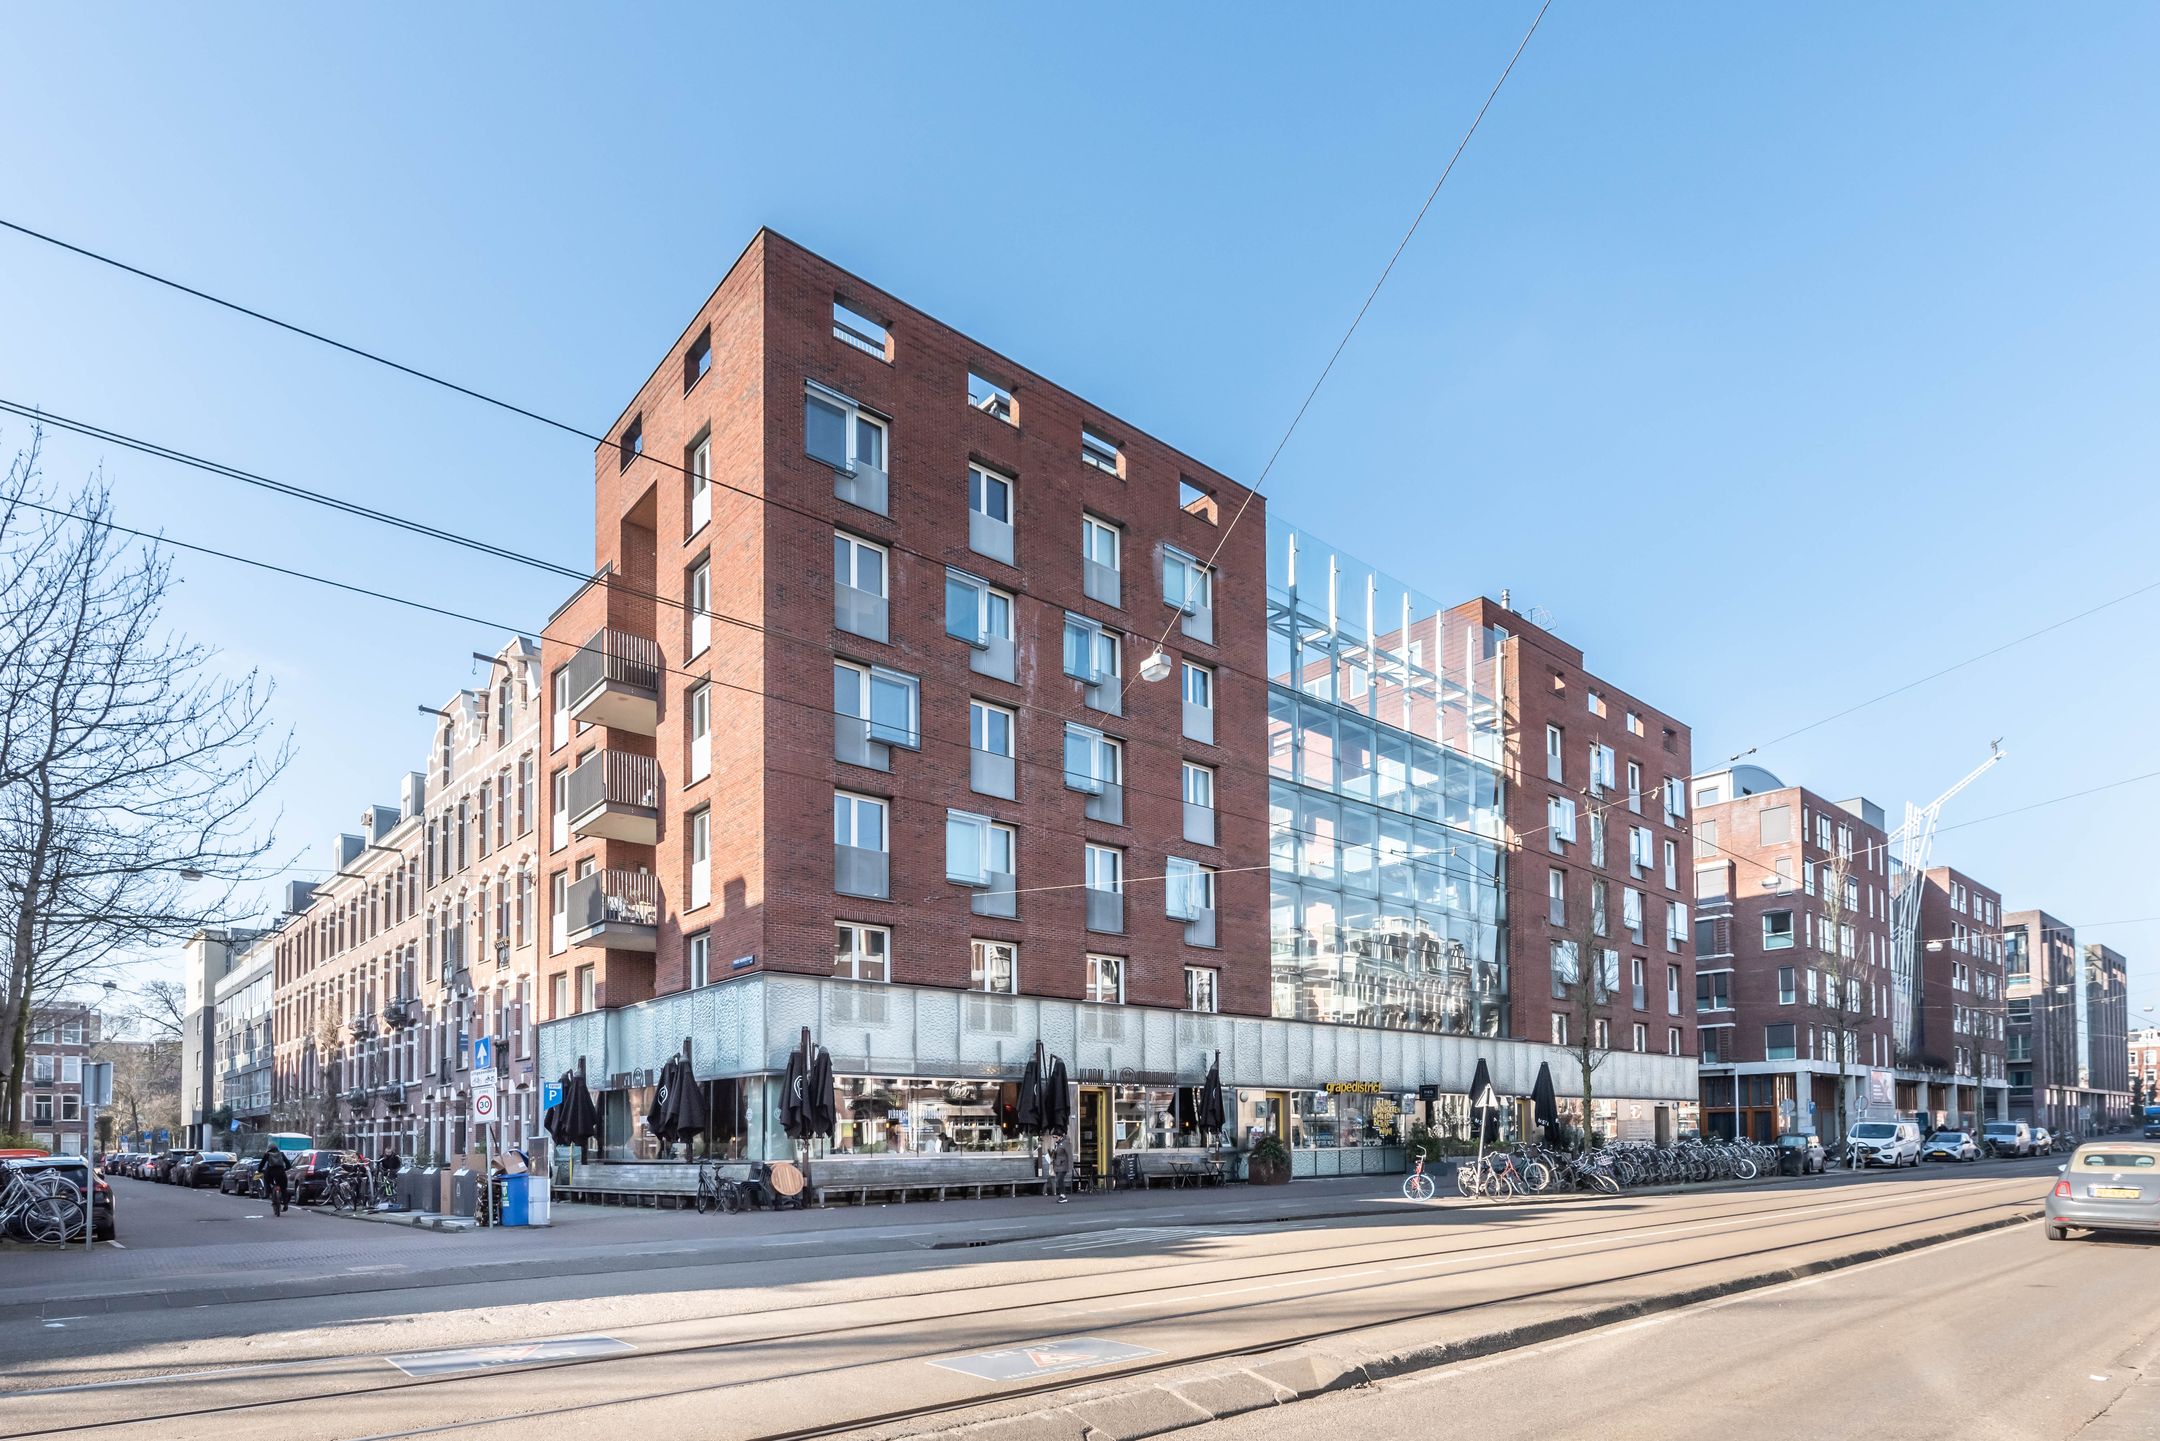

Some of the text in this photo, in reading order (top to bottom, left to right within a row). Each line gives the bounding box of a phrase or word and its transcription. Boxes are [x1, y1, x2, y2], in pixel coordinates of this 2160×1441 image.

[1326, 1081, 1381, 1094] grapedistrict
[549, 1090, 557, 1101] P
[480, 1101, 489, 1109] 30
